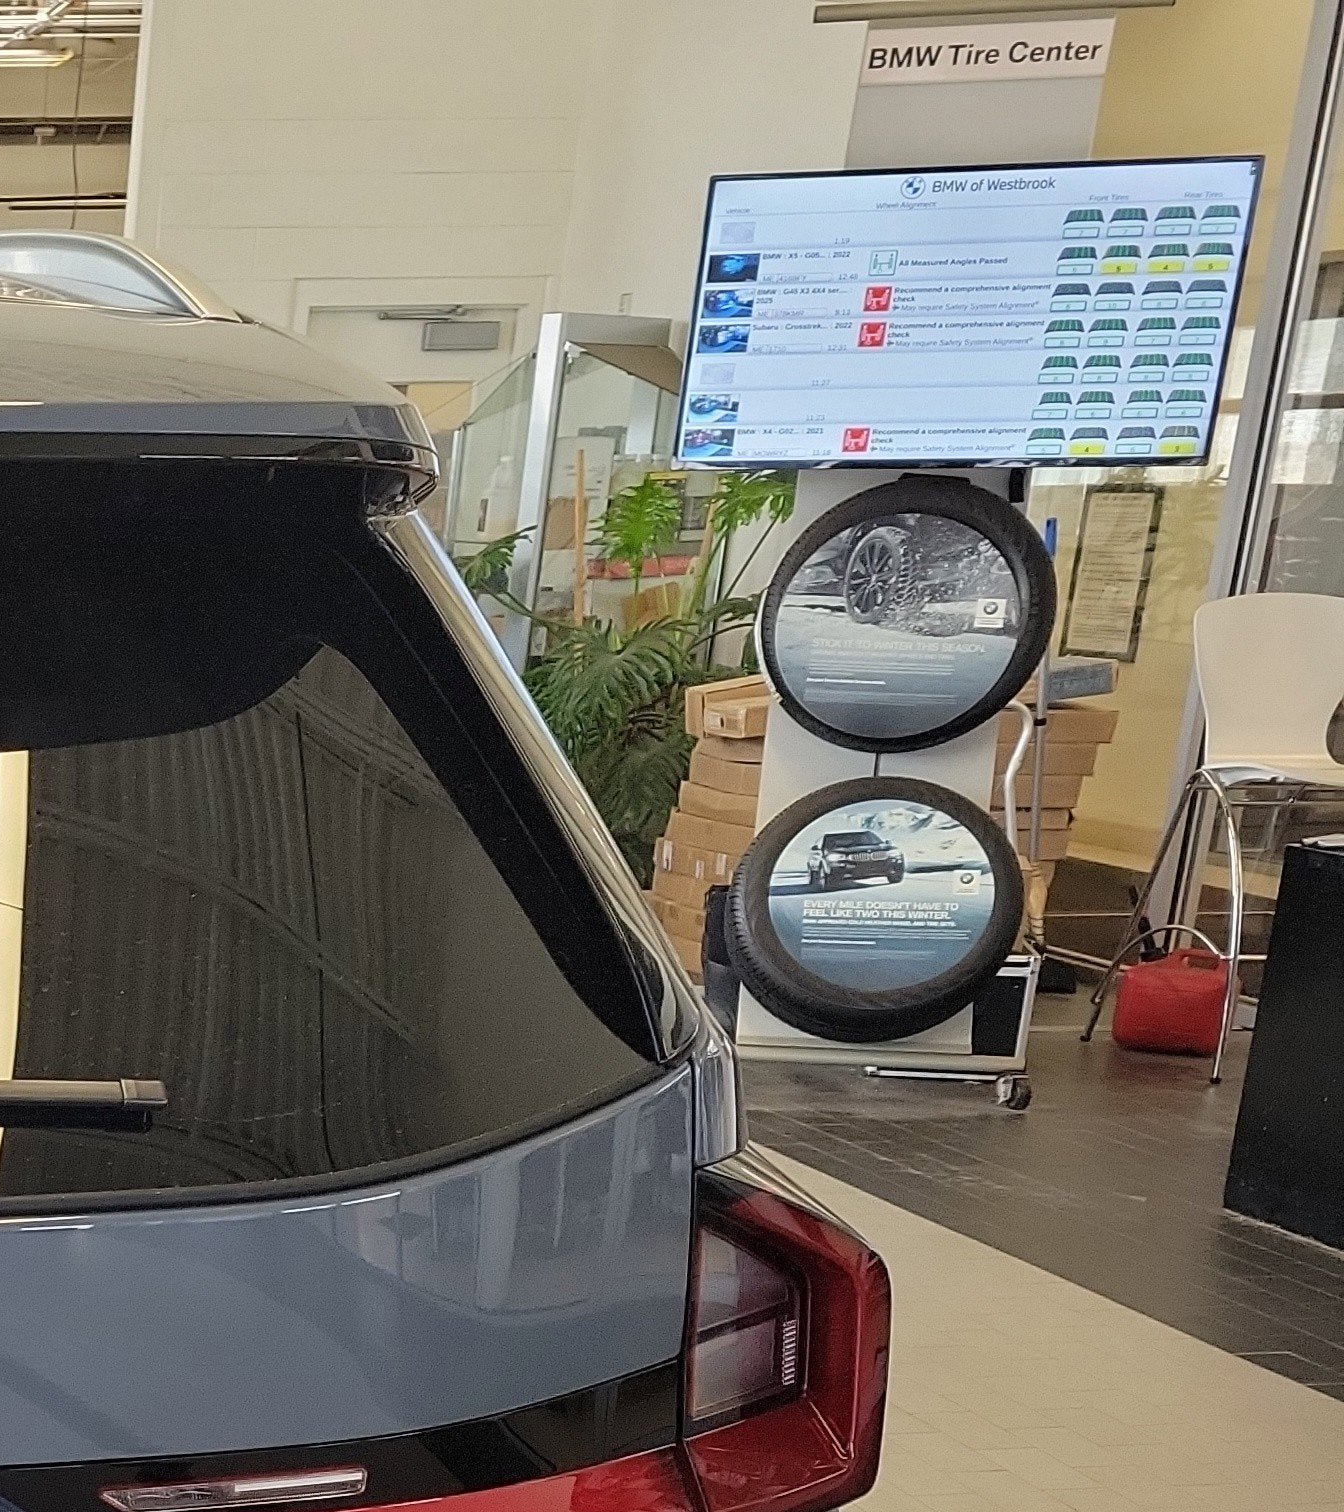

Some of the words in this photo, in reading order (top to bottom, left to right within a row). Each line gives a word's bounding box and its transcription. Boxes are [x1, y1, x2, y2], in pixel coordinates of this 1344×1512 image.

[868, 46, 942, 69] BMW
[948, 44, 999, 65] Tire
[1008, 41, 1103, 63] Center
[932, 179, 968, 193] BMW
[970, 179, 984, 192] of
[987, 177, 1056, 191] Westbrook
[900, 201, 936, 210] Alignment
[950, 258, 977, 267] Angles
[979, 257, 1008, 265] Passed
[950, 286, 1009, 294] comprehensive
[1011, 284, 1051, 292] alignment
[945, 303, 968, 311] Safety
[971, 302, 998, 310] System
[945, 321, 1003, 329] comprehensive
[1005, 319, 1045, 327] alignment
[894, 340, 909, 348] May
[940, 339, 962, 347] Safety
[965, 338, 991, 346] System
[928, 427, 986, 435] comprehensive
[988, 427, 1026, 435] alignment
[922, 445, 944, 453] Safety
[947, 444, 973, 452] System
[916, 641, 939, 651] THIS
[804, 900, 838, 908] EVERY
[839, 900, 864, 909] MILE
[866, 901, 912, 910] DOESN'T
[914, 902, 942, 910] HAVE
[943, 902, 959, 911] TO
[804, 908, 830, 917] FEEL
[830, 909, 854, 917] LIKE
[854, 909, 880, 918] TWO
[881, 910, 906, 919] THIS
[908, 911, 952, 920] WINTER.
